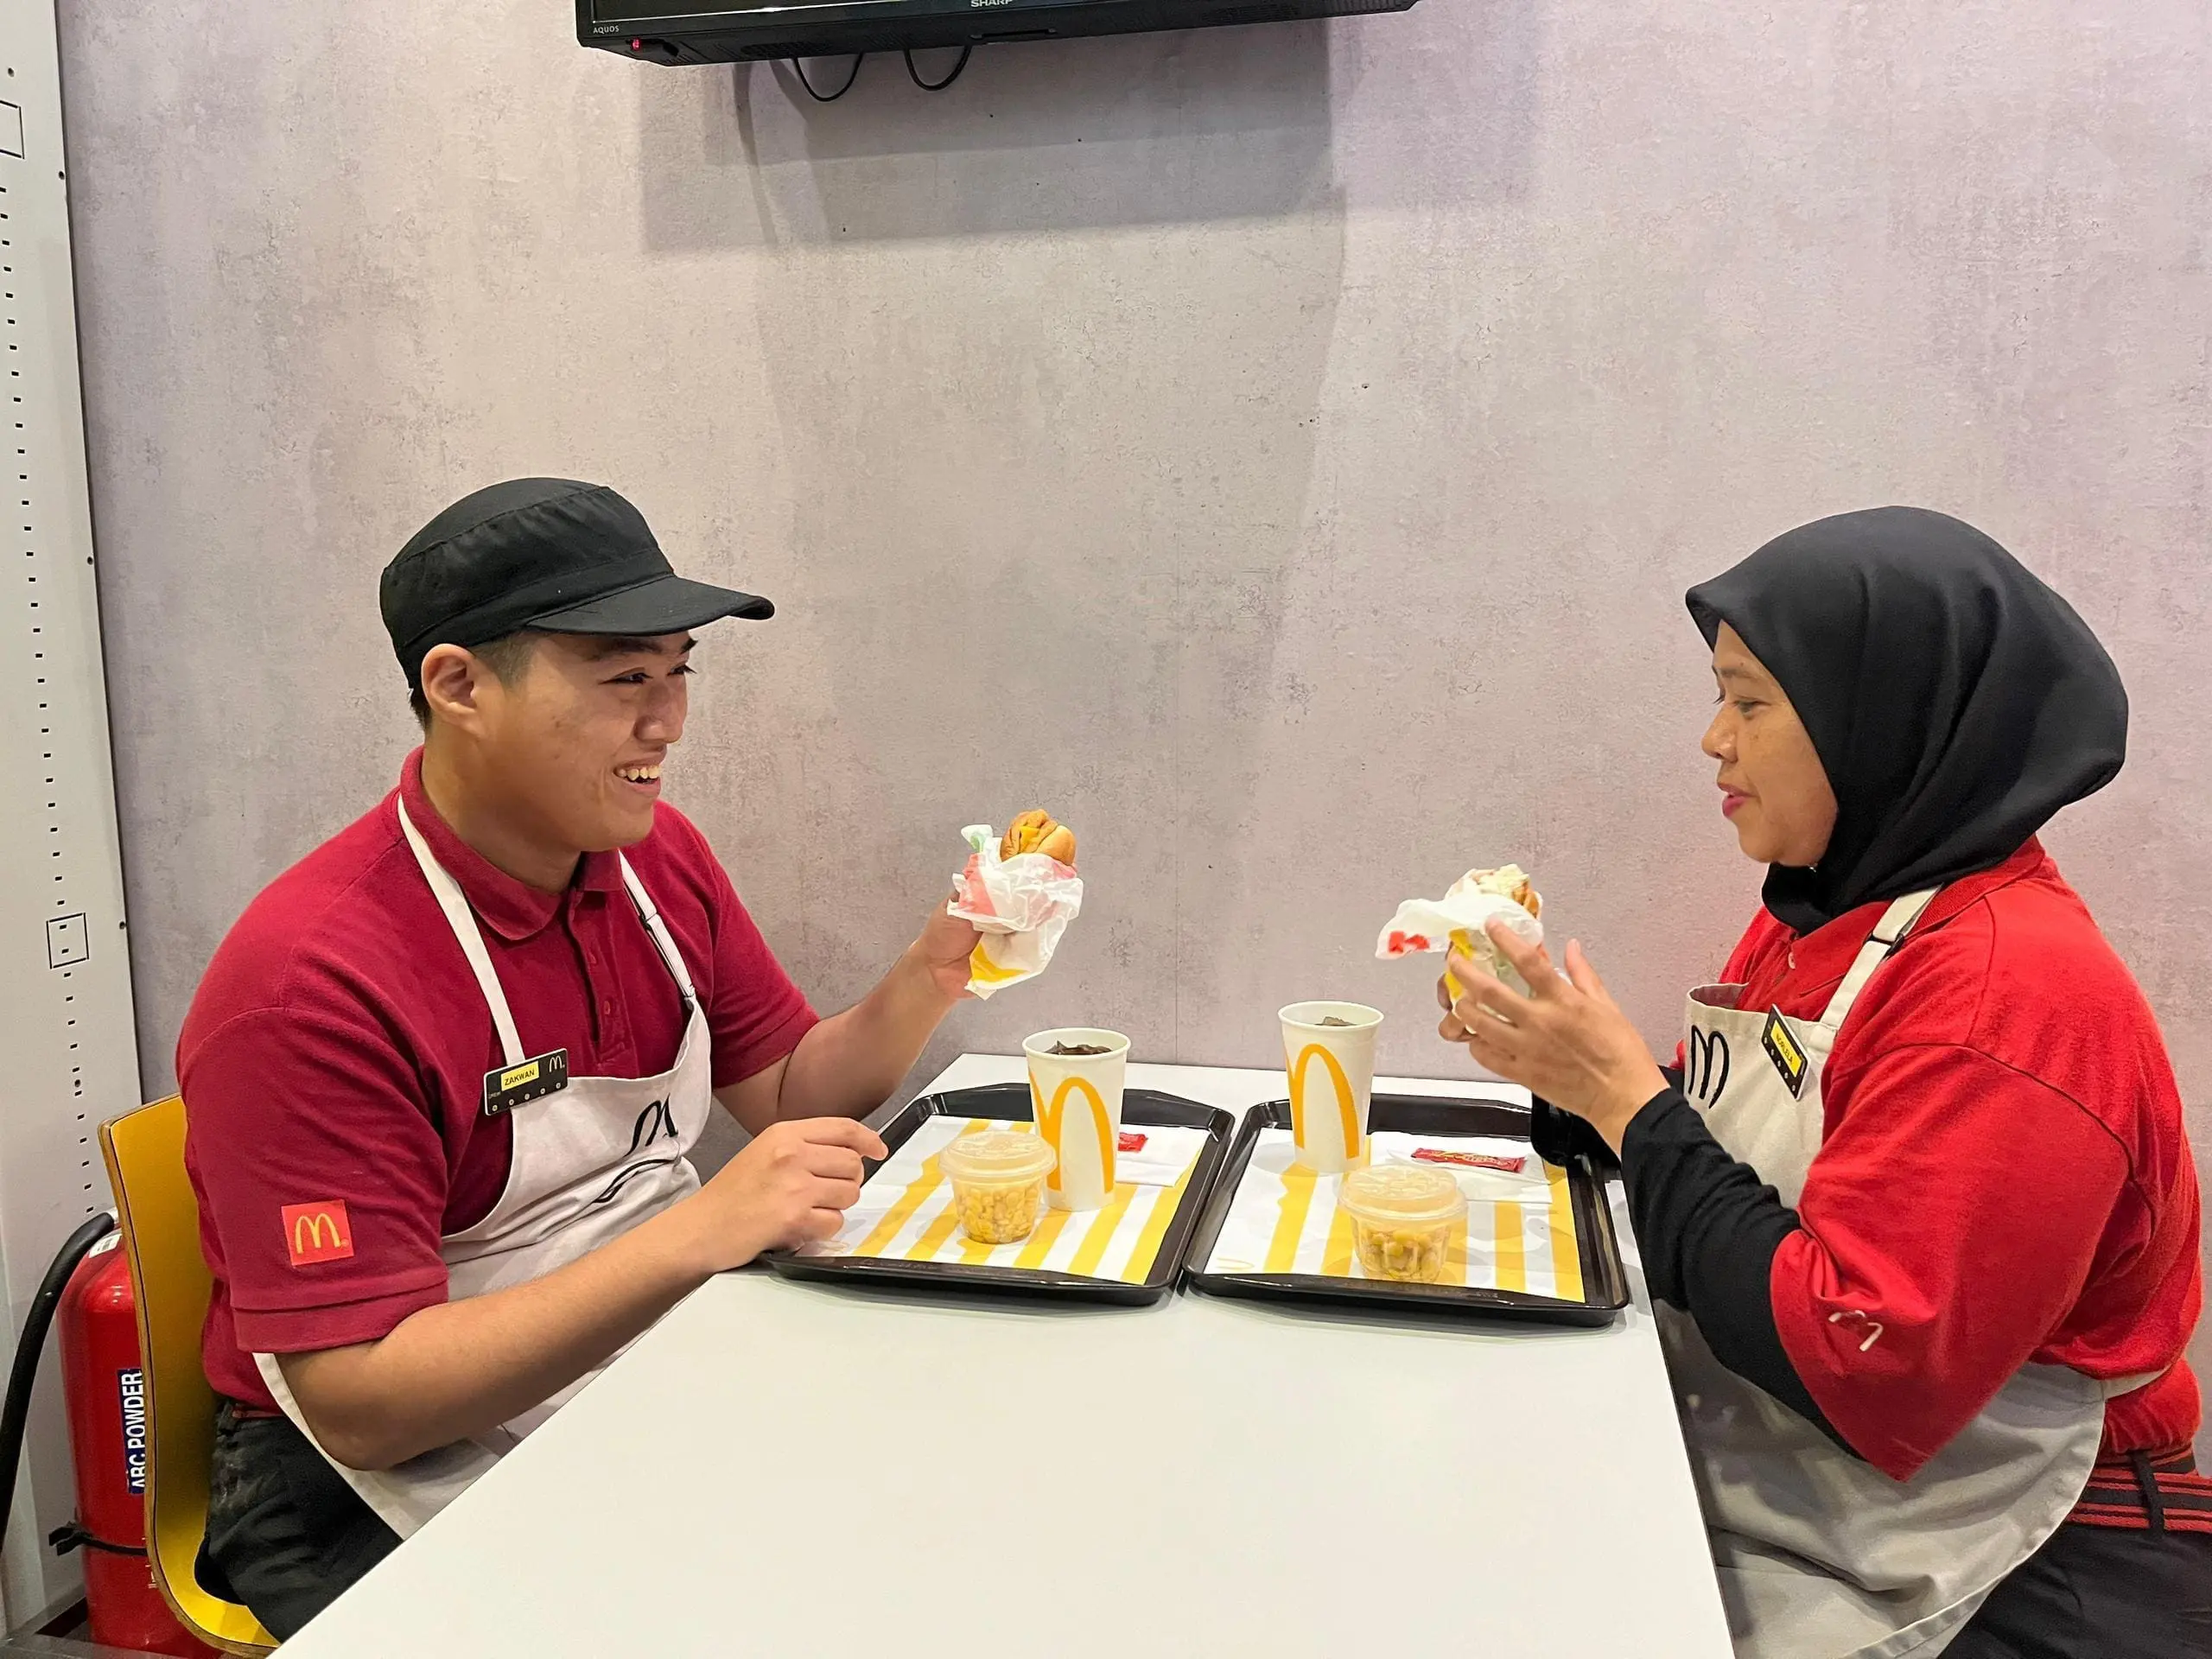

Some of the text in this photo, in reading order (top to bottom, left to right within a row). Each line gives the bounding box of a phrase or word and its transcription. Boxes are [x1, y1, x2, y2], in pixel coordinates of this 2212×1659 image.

[593, 25, 620, 35] AQUOS
[504, 1068, 535, 1086] ZAKWAN
[121, 1371, 146, 1449] POWDER
